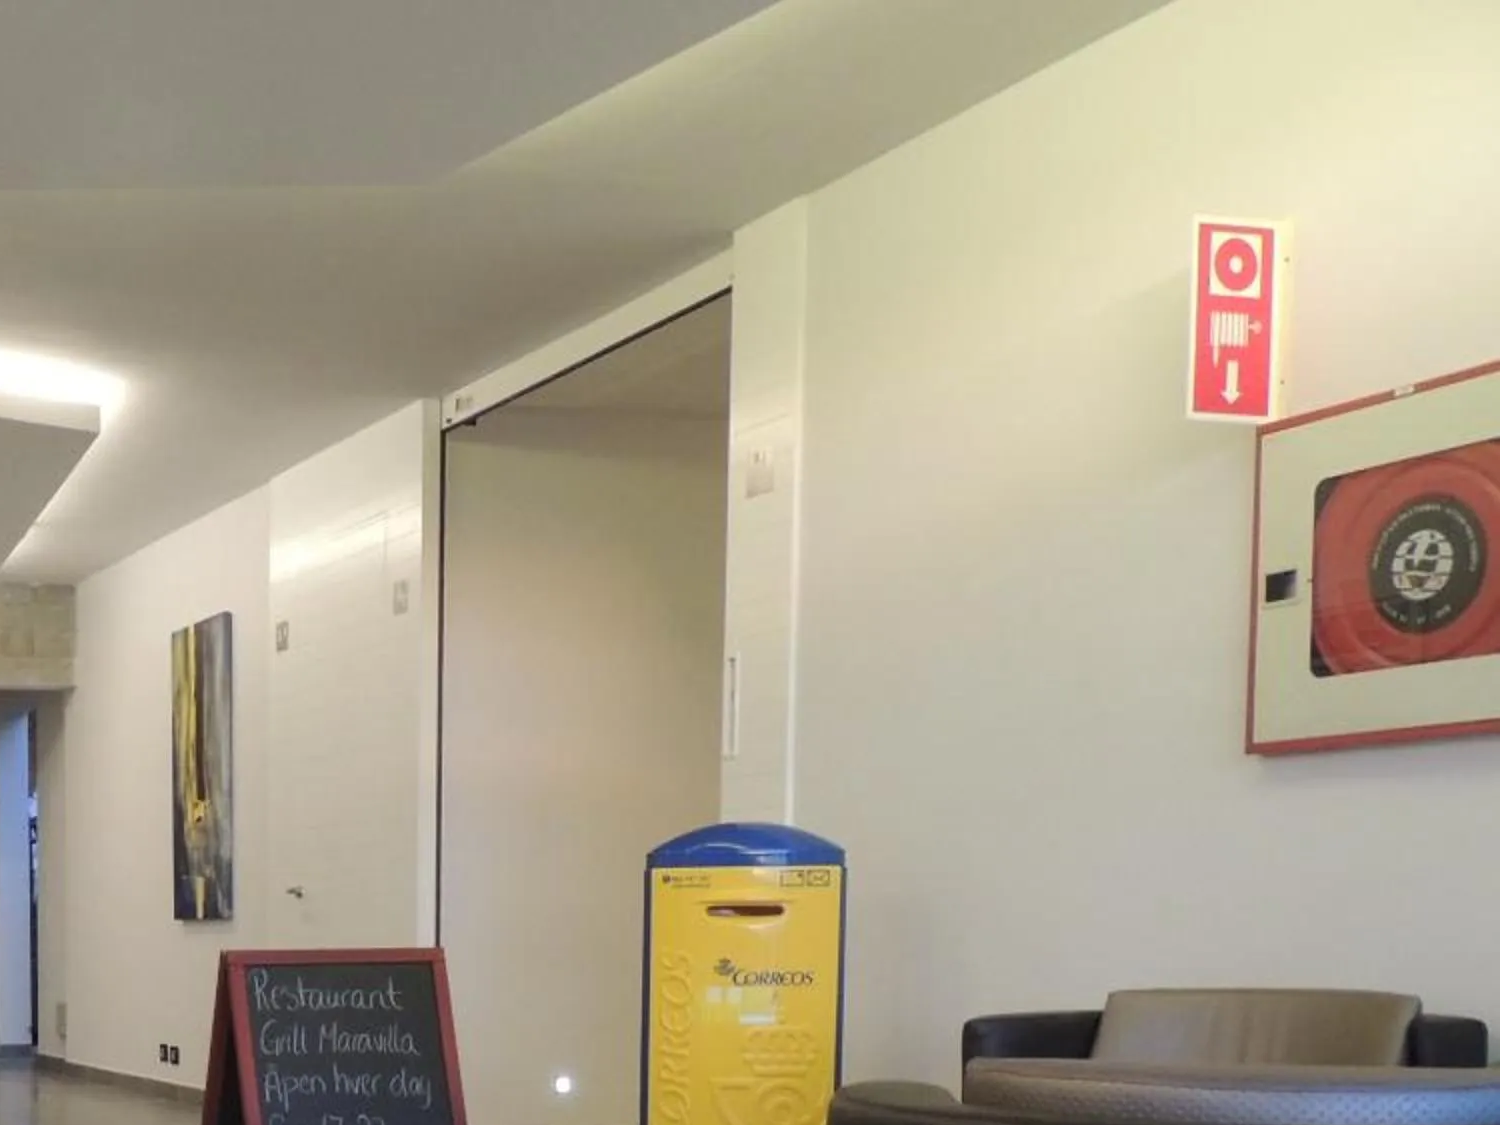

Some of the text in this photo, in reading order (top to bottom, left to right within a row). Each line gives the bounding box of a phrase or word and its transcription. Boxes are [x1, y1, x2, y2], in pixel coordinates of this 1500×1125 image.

[253, 969, 404, 1011] Restaurant
[732, 969, 814, 986] CORREOS
[260, 1019, 421, 1056] Grill Maravilla
[332, 1062, 382, 1096] hver
